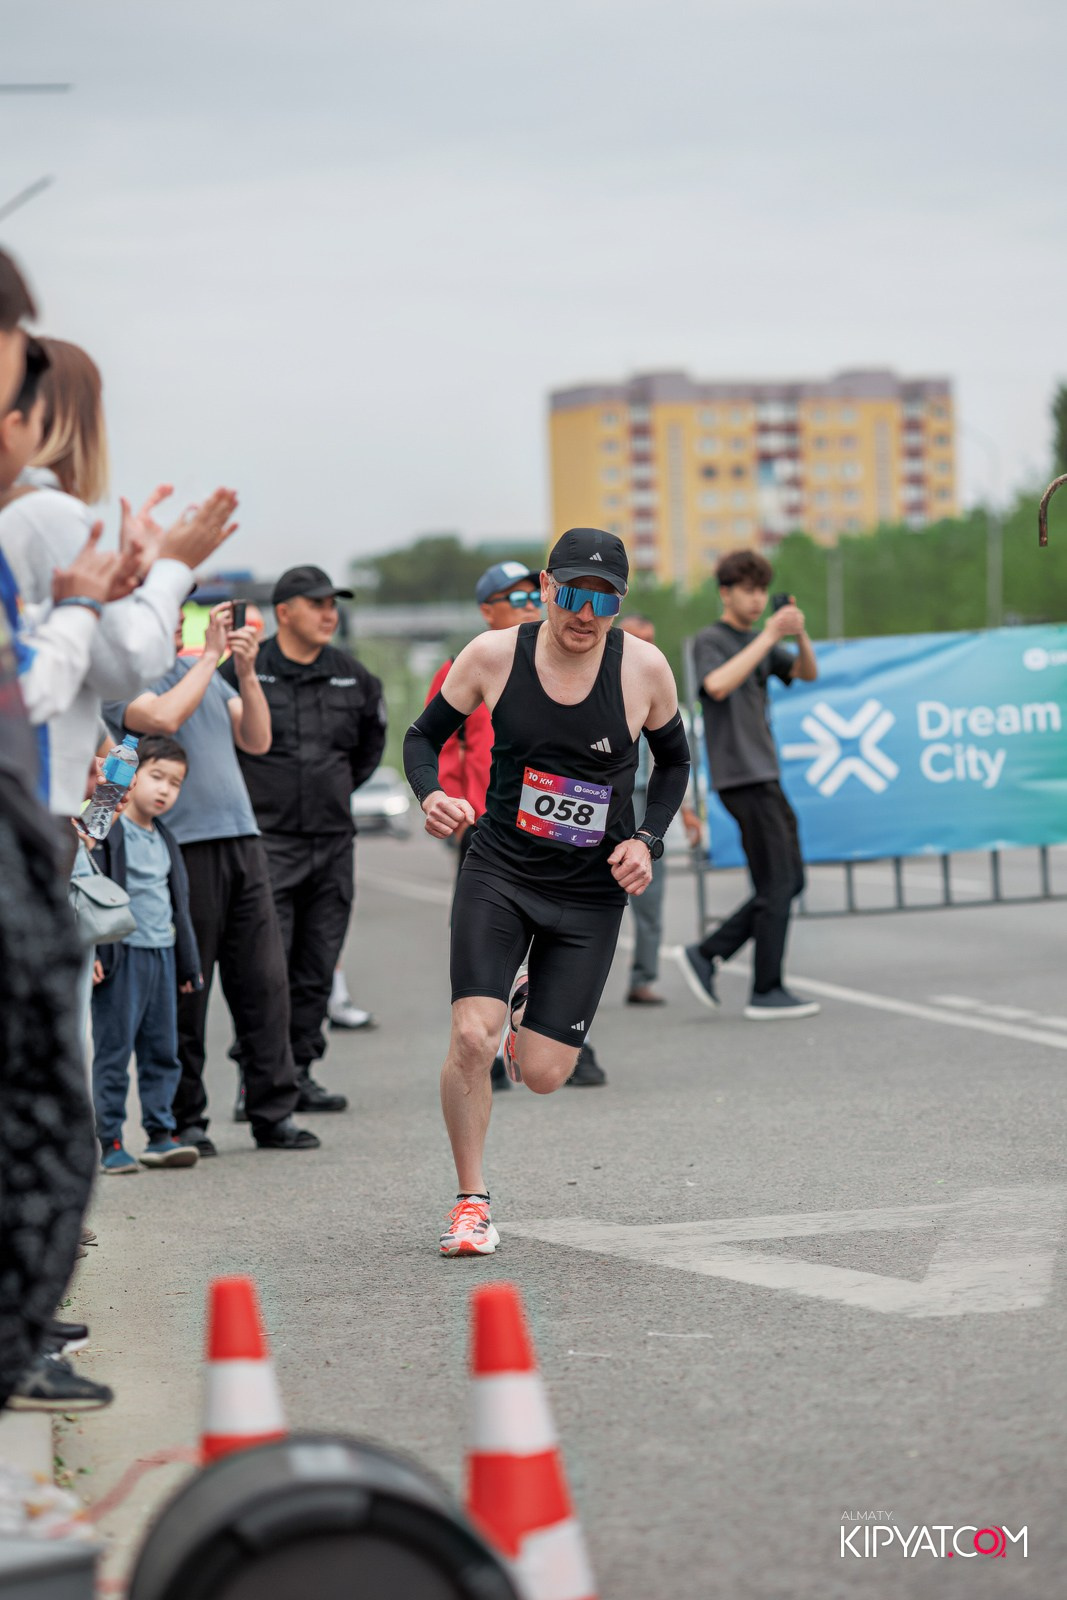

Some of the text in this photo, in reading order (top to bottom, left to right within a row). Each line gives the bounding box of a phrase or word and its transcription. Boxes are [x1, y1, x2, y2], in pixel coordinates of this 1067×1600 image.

[916, 700, 1062, 740] Dream
[528, 772, 554, 786] 10 KM
[919, 743, 1007, 789] City
[534, 794, 595, 826] 058
